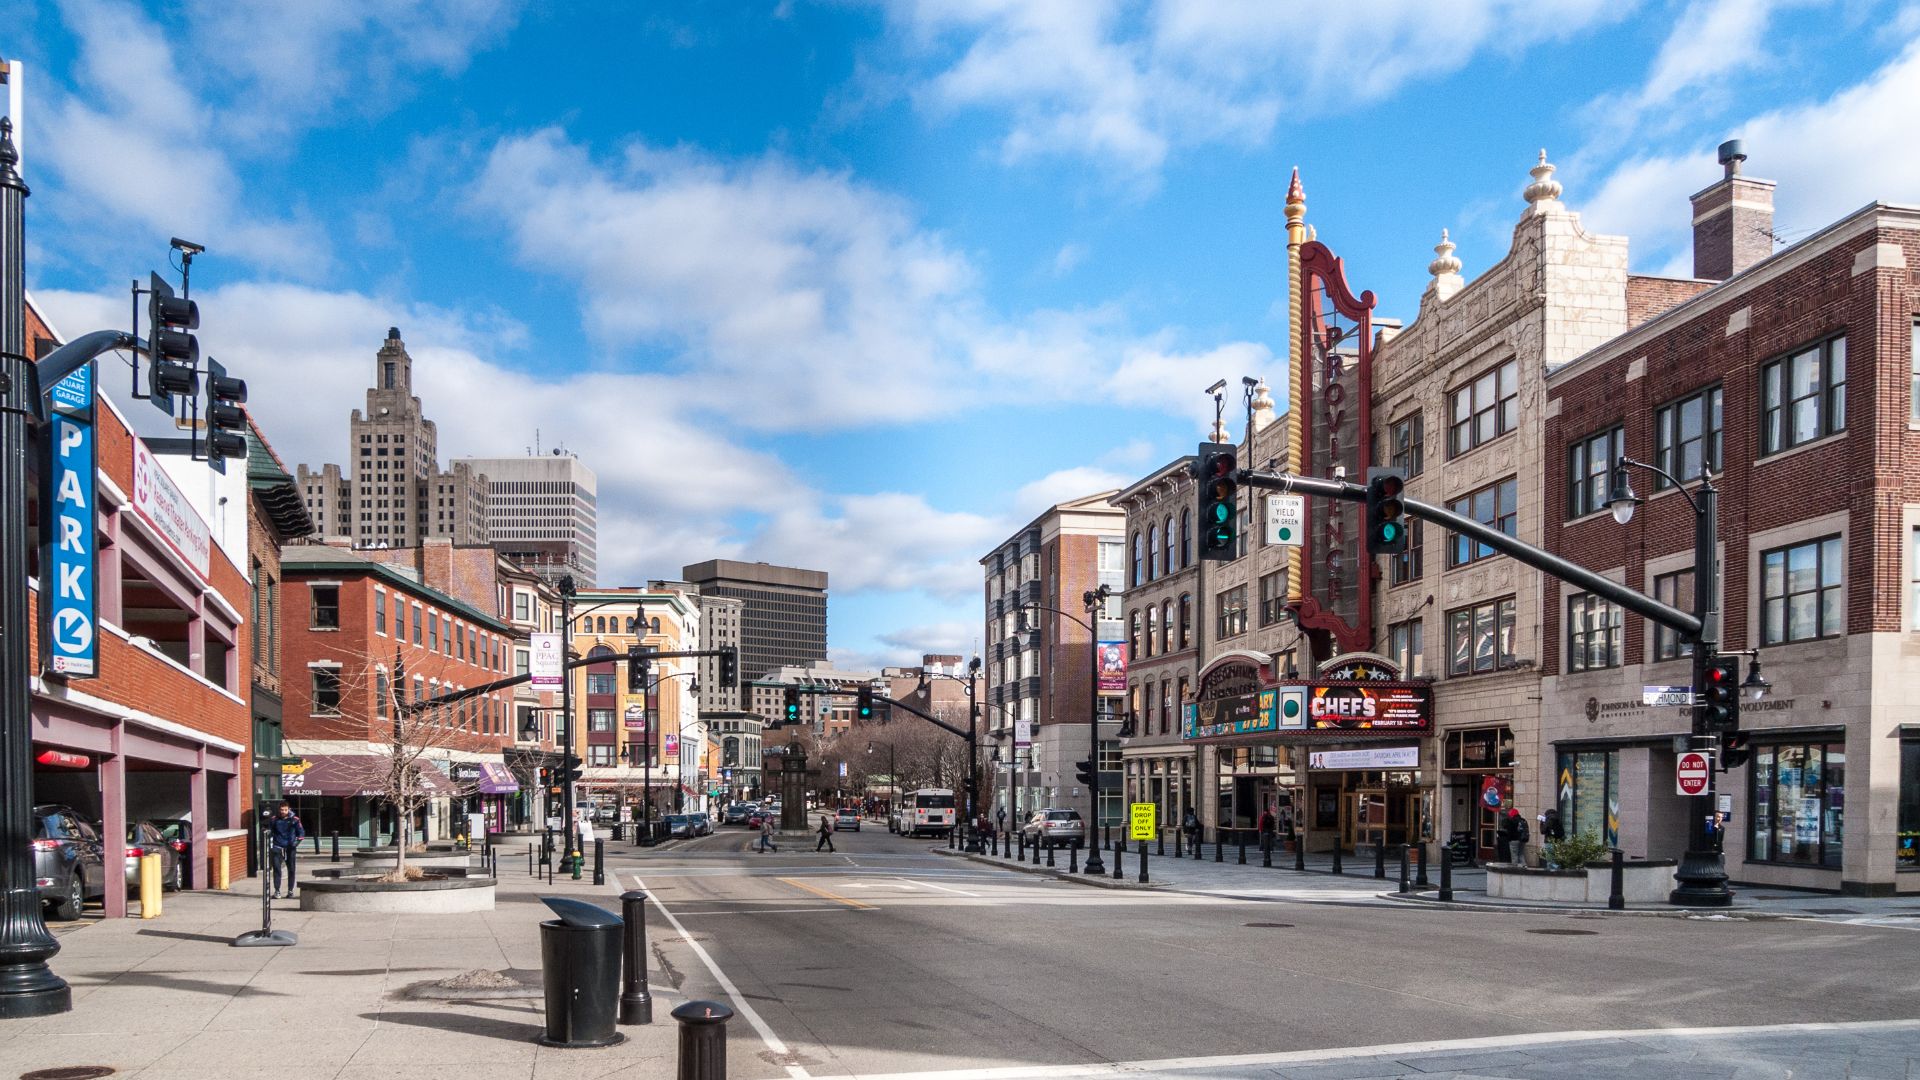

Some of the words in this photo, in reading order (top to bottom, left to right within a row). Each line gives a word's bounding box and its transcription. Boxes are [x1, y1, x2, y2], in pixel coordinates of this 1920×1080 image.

[60, 380, 86, 392] QUARE
[56, 389, 86, 406] GARAGE
[56, 420, 86, 601] PARK
[1312, 697, 1376, 717] CHEFS
[1601, 702, 1630, 711] JOHNSON
[1630, 700, 1636, 709] &
[1739, 700, 1796, 712] NVOLVEMENT
